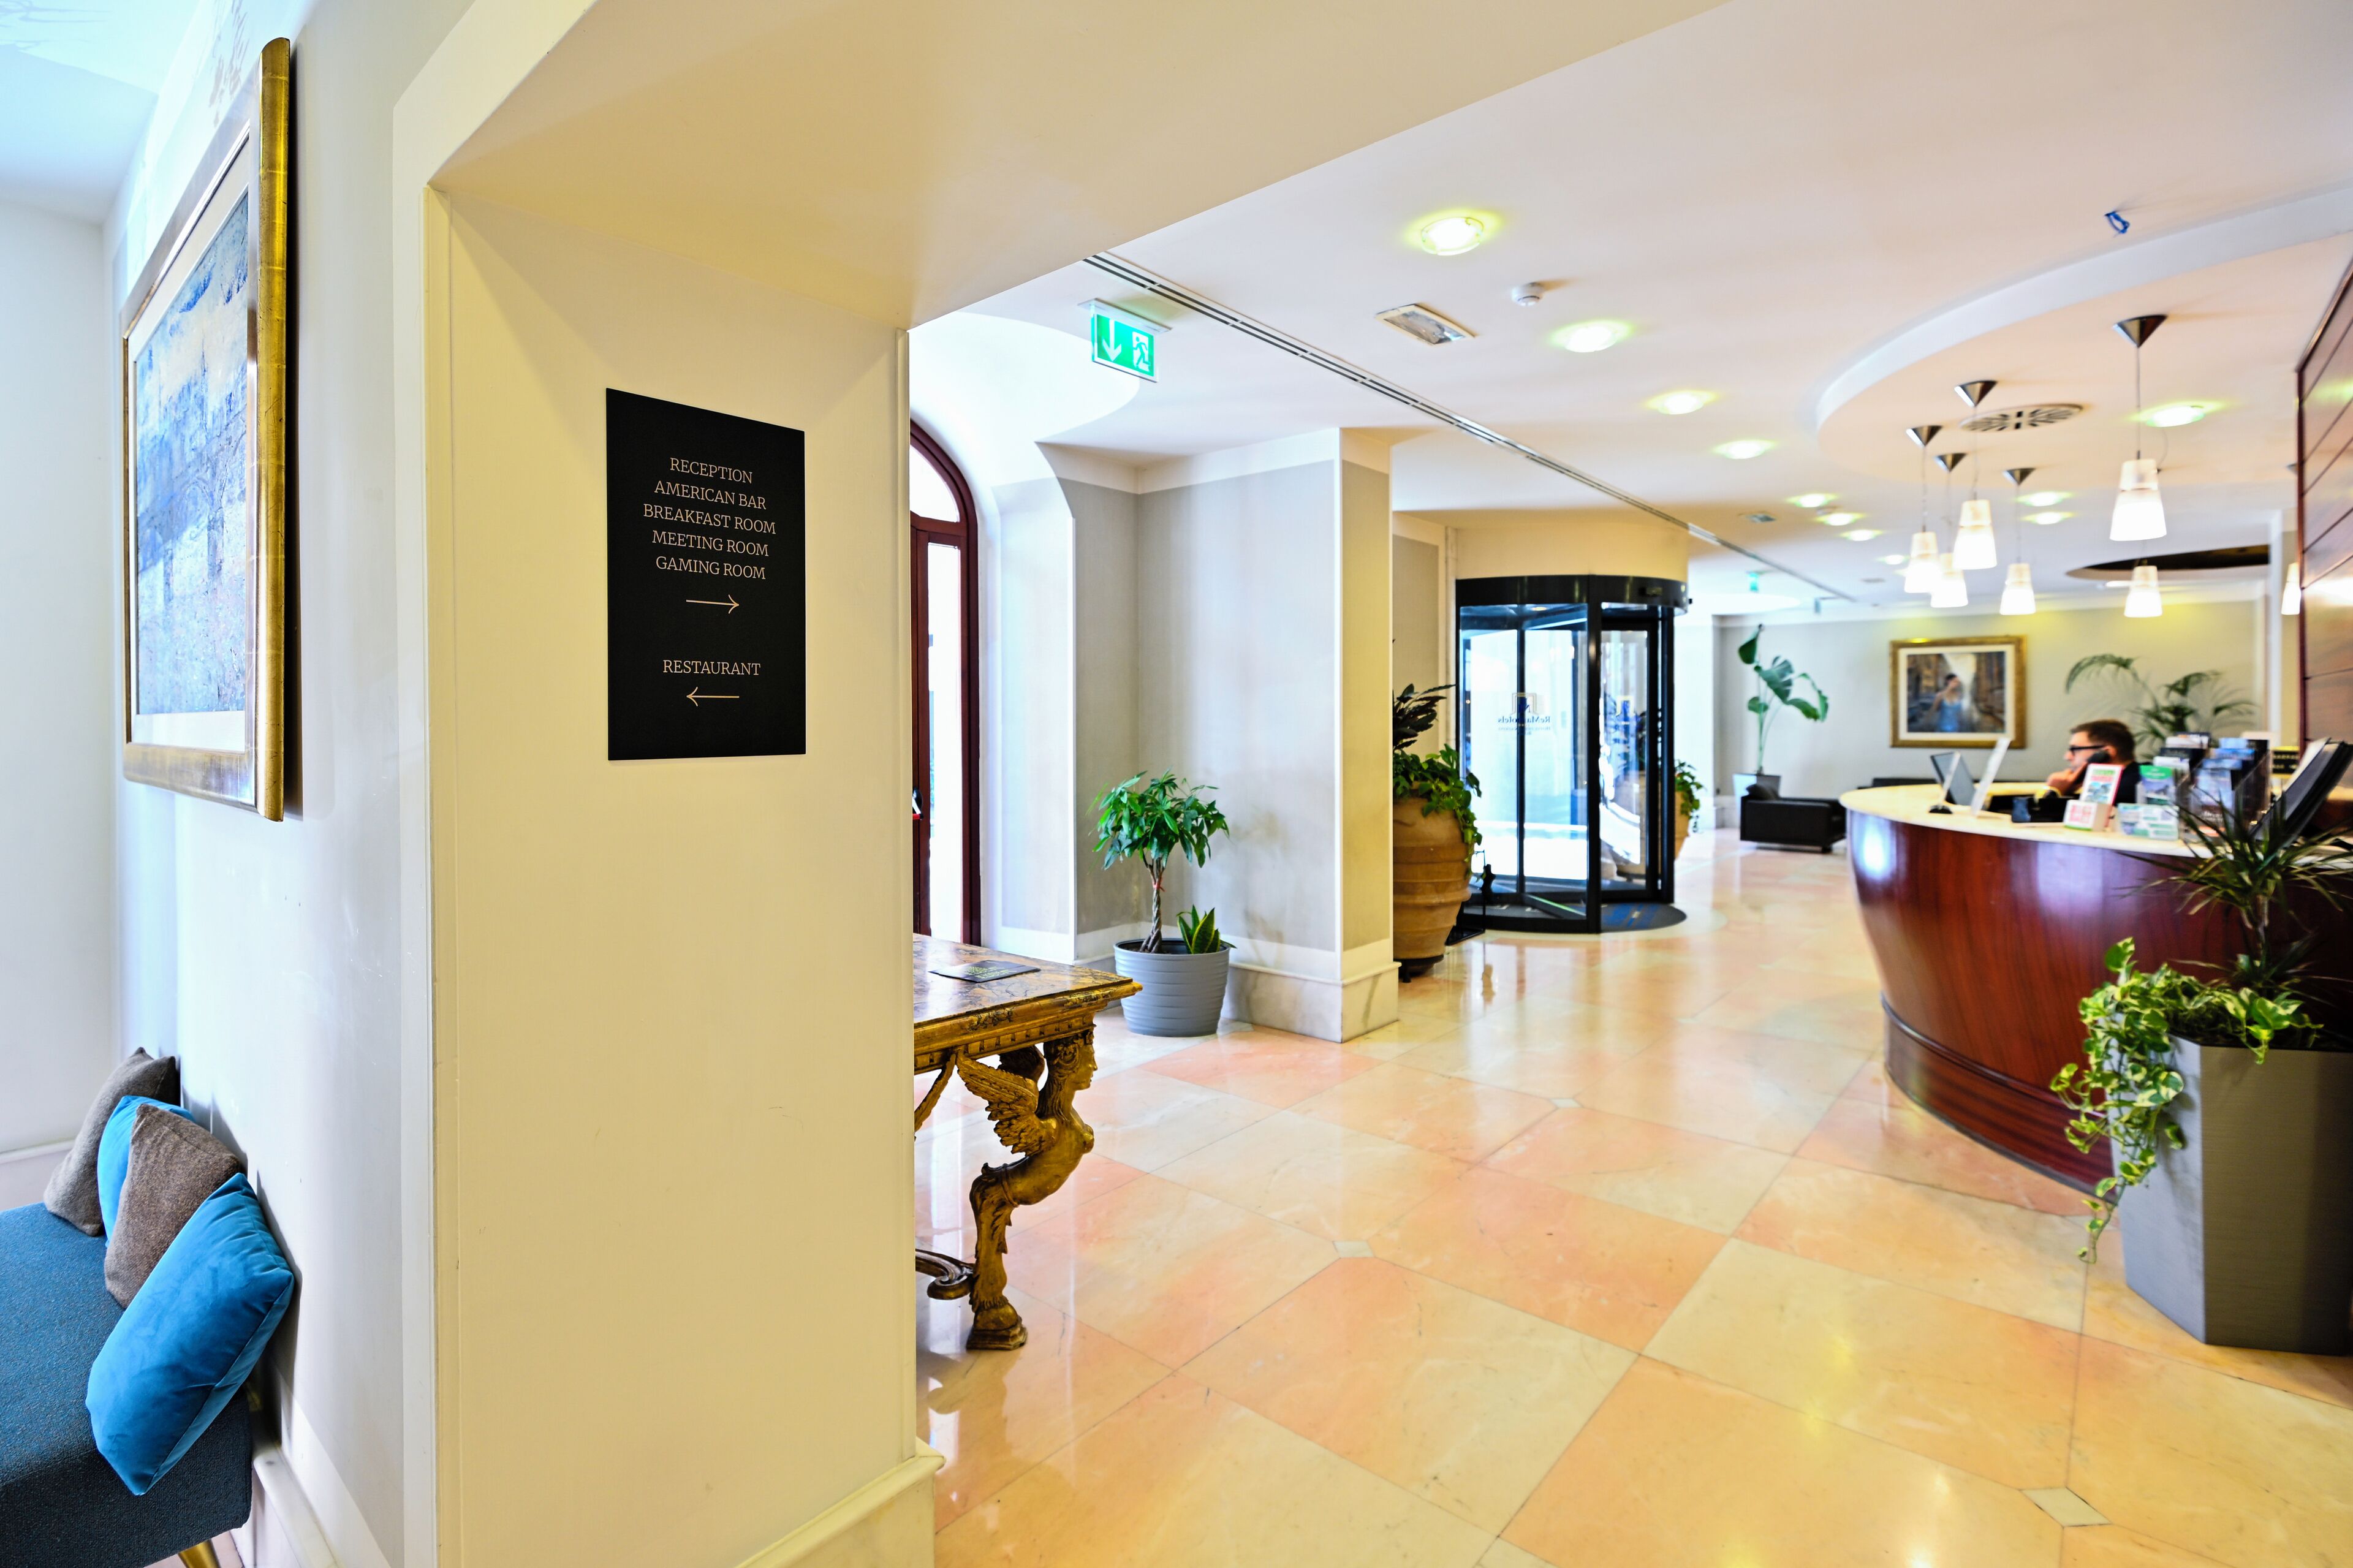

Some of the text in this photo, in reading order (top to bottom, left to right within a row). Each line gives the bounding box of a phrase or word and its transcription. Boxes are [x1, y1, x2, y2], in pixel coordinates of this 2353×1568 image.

[670, 458, 752, 483] RECEPTION
[654, 480, 766, 509] AMERICAN BAR
[643, 504, 776, 534] BREAKFAST ROOM
[652, 530, 768, 556] MEETING ROOM
[656, 556, 765, 579] GAMING ROOM
[663, 660, 760, 675] RESTAURANT
